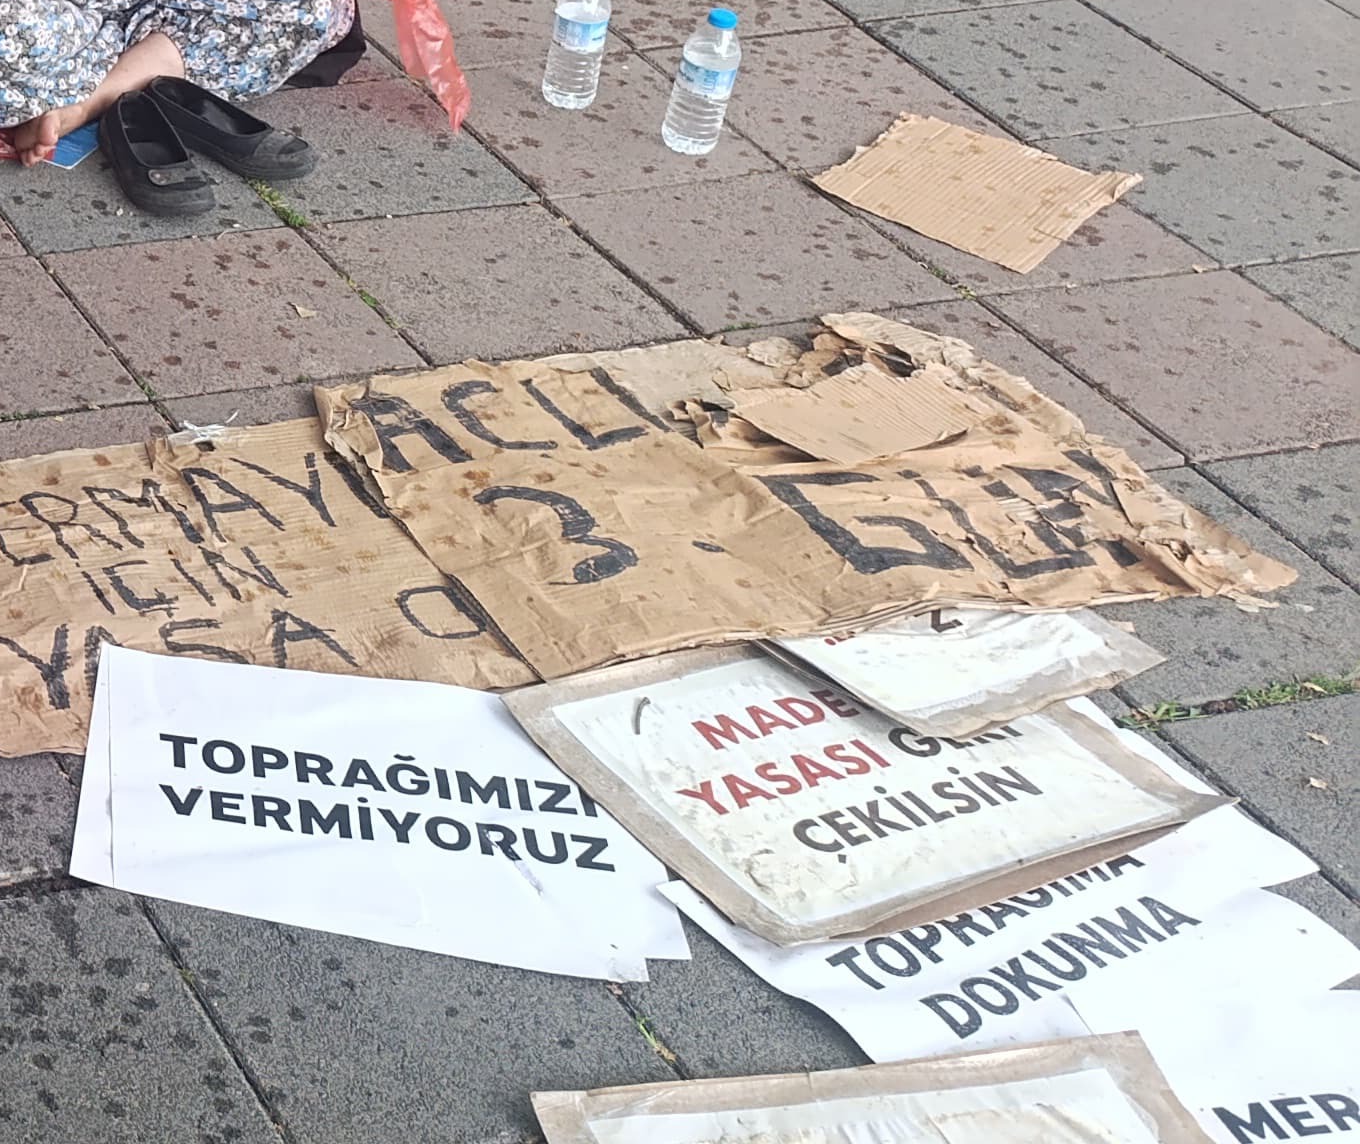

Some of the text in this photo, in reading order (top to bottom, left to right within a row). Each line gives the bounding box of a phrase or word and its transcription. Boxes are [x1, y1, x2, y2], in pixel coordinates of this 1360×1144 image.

[691, 690, 860, 750] MADE
[160, 733, 598, 818] TOPRAĞIMIZI
[675, 739, 893, 816] YASASI
[793, 765, 1044, 864] ÇEKİLSİN
[159, 784, 615, 872] VERMİYORUZ
[919, 896, 1202, 1039] DOKUNMA
